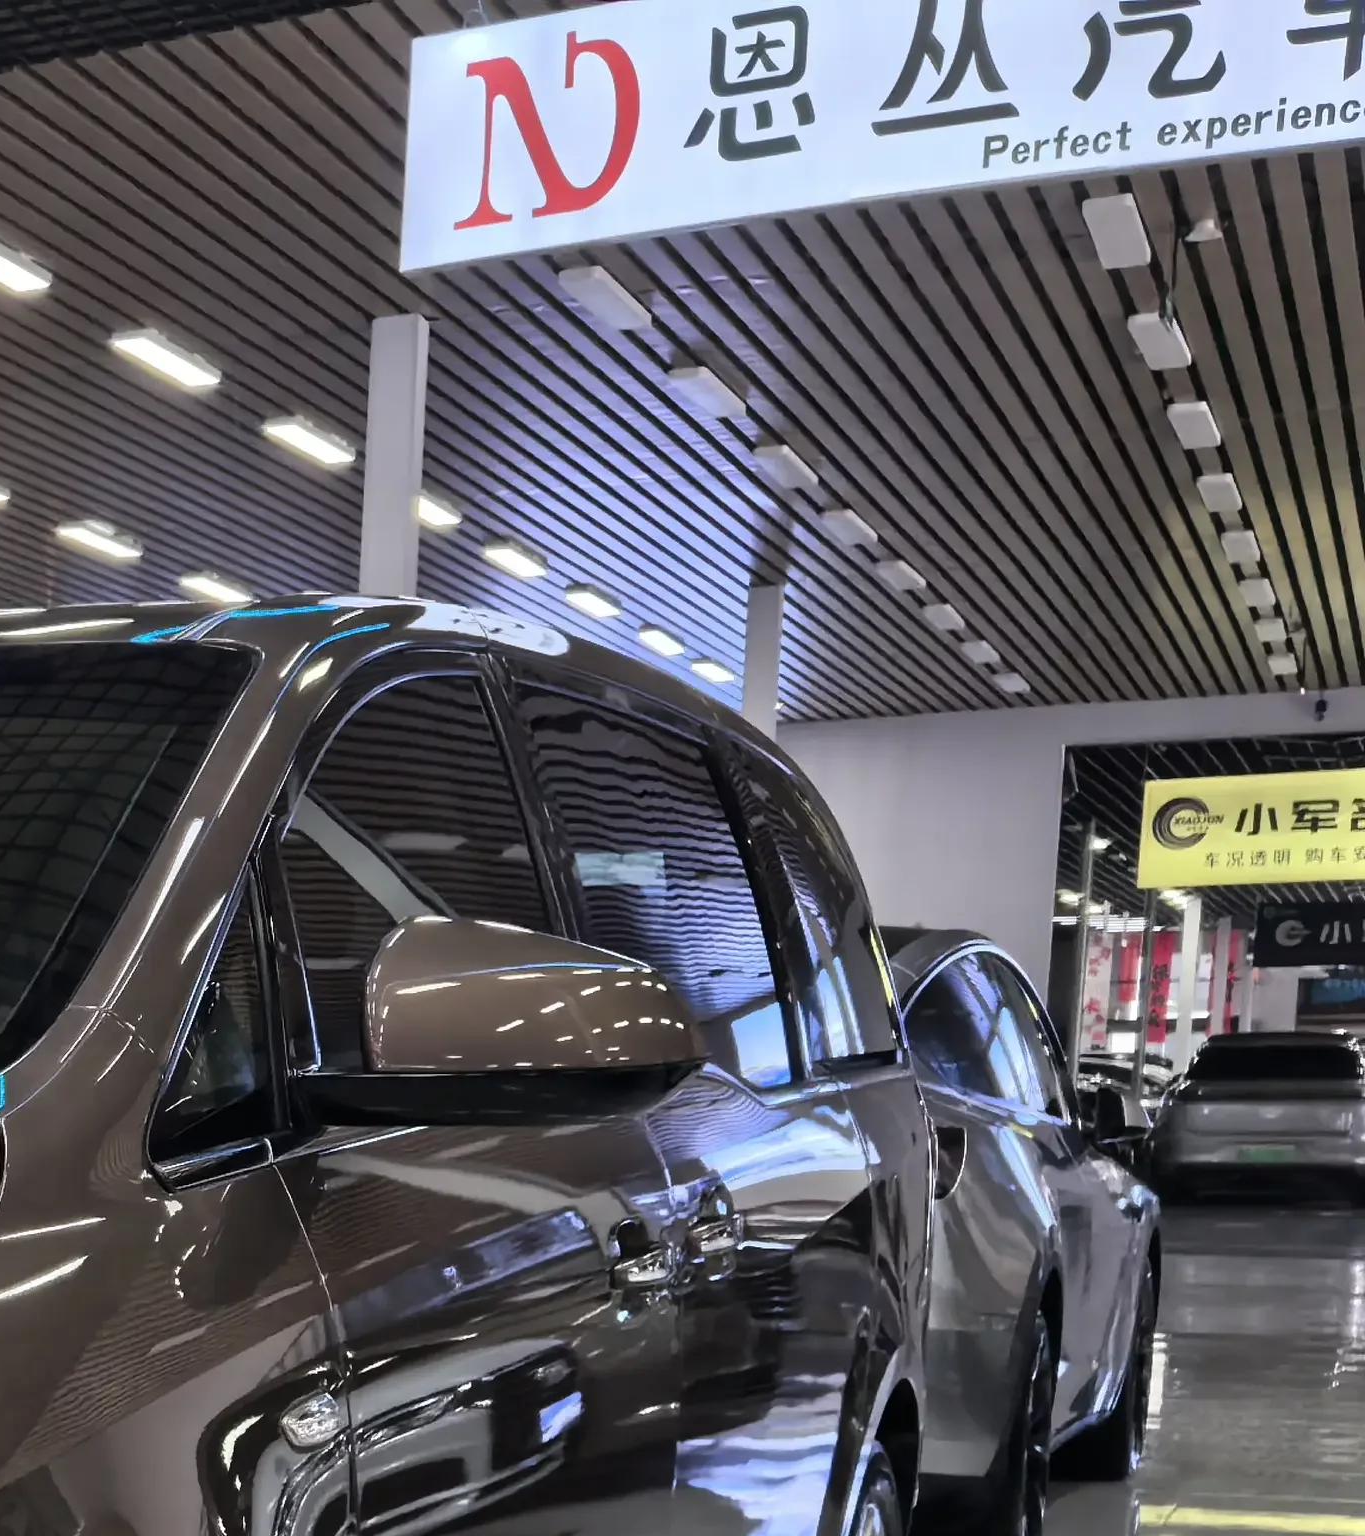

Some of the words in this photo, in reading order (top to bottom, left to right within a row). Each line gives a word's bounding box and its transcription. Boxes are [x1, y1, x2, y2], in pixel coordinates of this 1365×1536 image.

[982, 121, 1133, 169] Perfect
[1156, 96, 1365, 149] experienc
[1205, 849, 1291, 869] 车况透明
